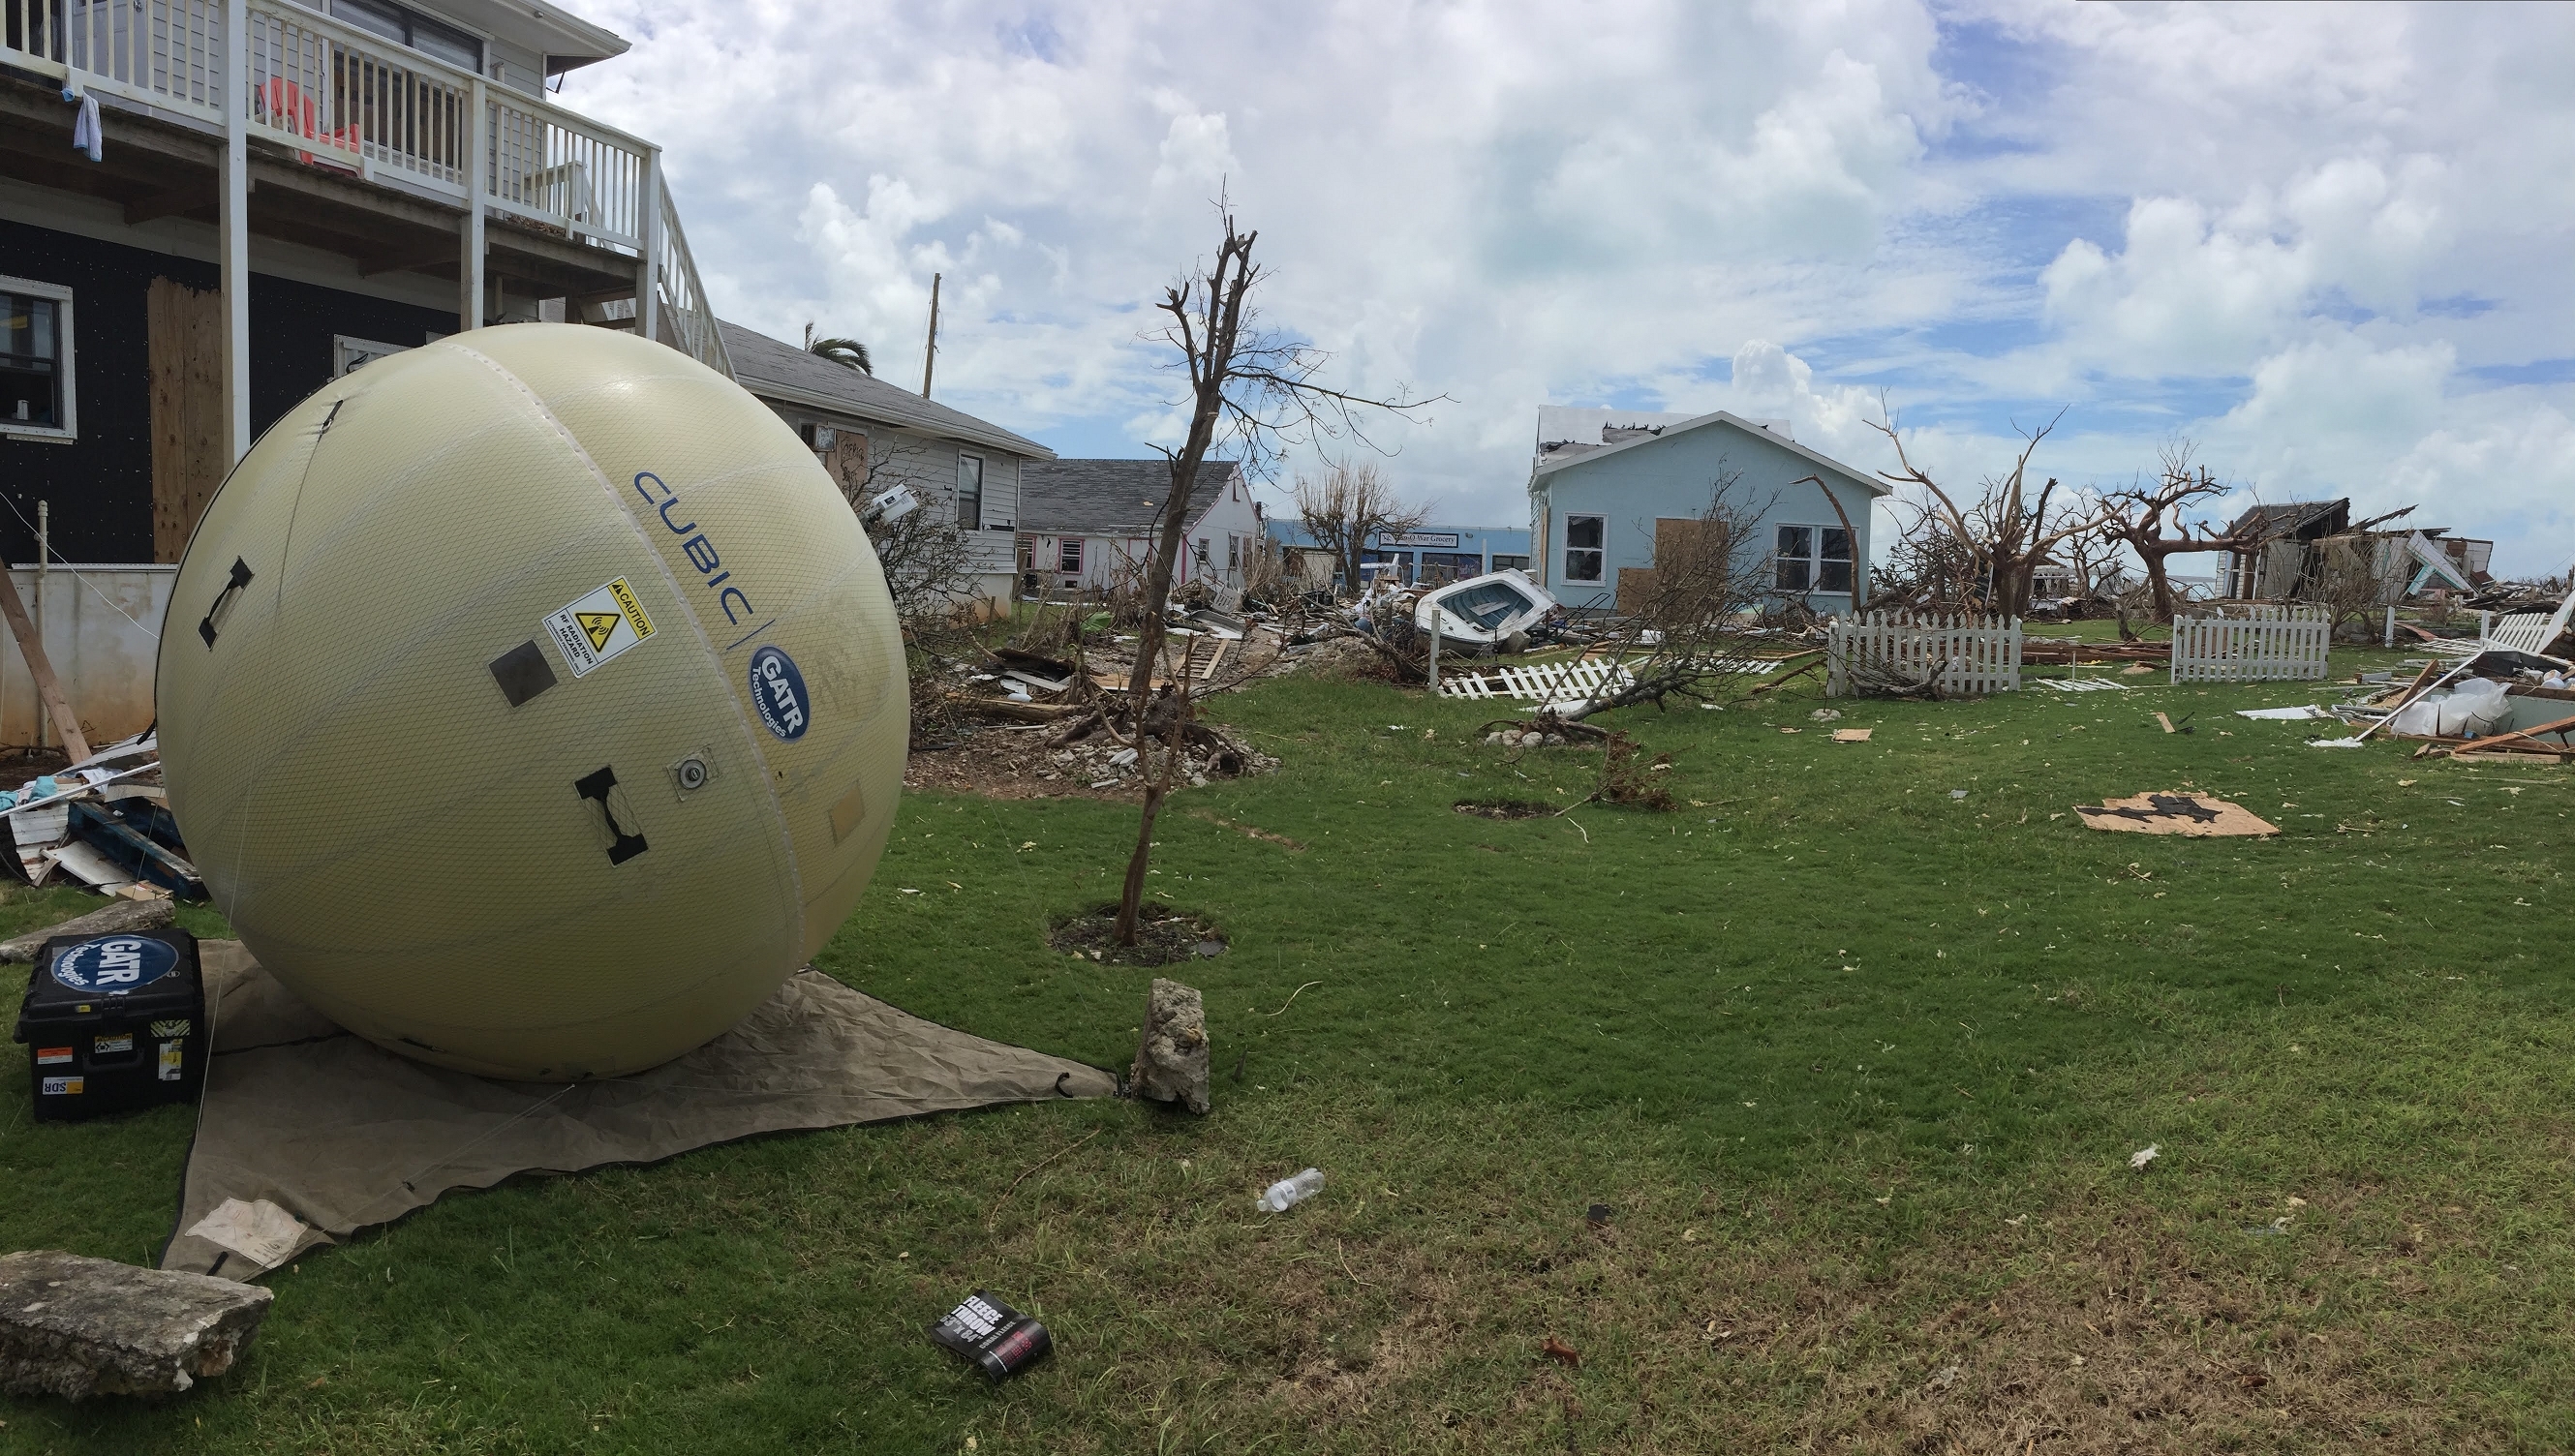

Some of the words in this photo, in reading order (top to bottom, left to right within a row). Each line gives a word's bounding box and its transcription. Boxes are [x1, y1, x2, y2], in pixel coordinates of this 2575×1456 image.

[633, 471, 754, 625] CUBIC
[1430, 534, 1456, 545] Grocery
[620, 592, 651, 636] CAUTION
[559, 627, 581, 658] HAZARD
[560, 614, 570, 624] RF
[567, 624, 594, 665] RADIATION
[751, 666, 786, 739] Technologies
[761, 655, 803, 735] GATR
[58, 943, 101, 986] Technologies
[95, 940, 141, 986] GATR
[45, 1081, 67, 1093] SDR
[950, 1304, 996, 1337] THROW
[963, 1294, 1004, 1325] FLEECE
[996, 1320, 1017, 1337] FLEECE
